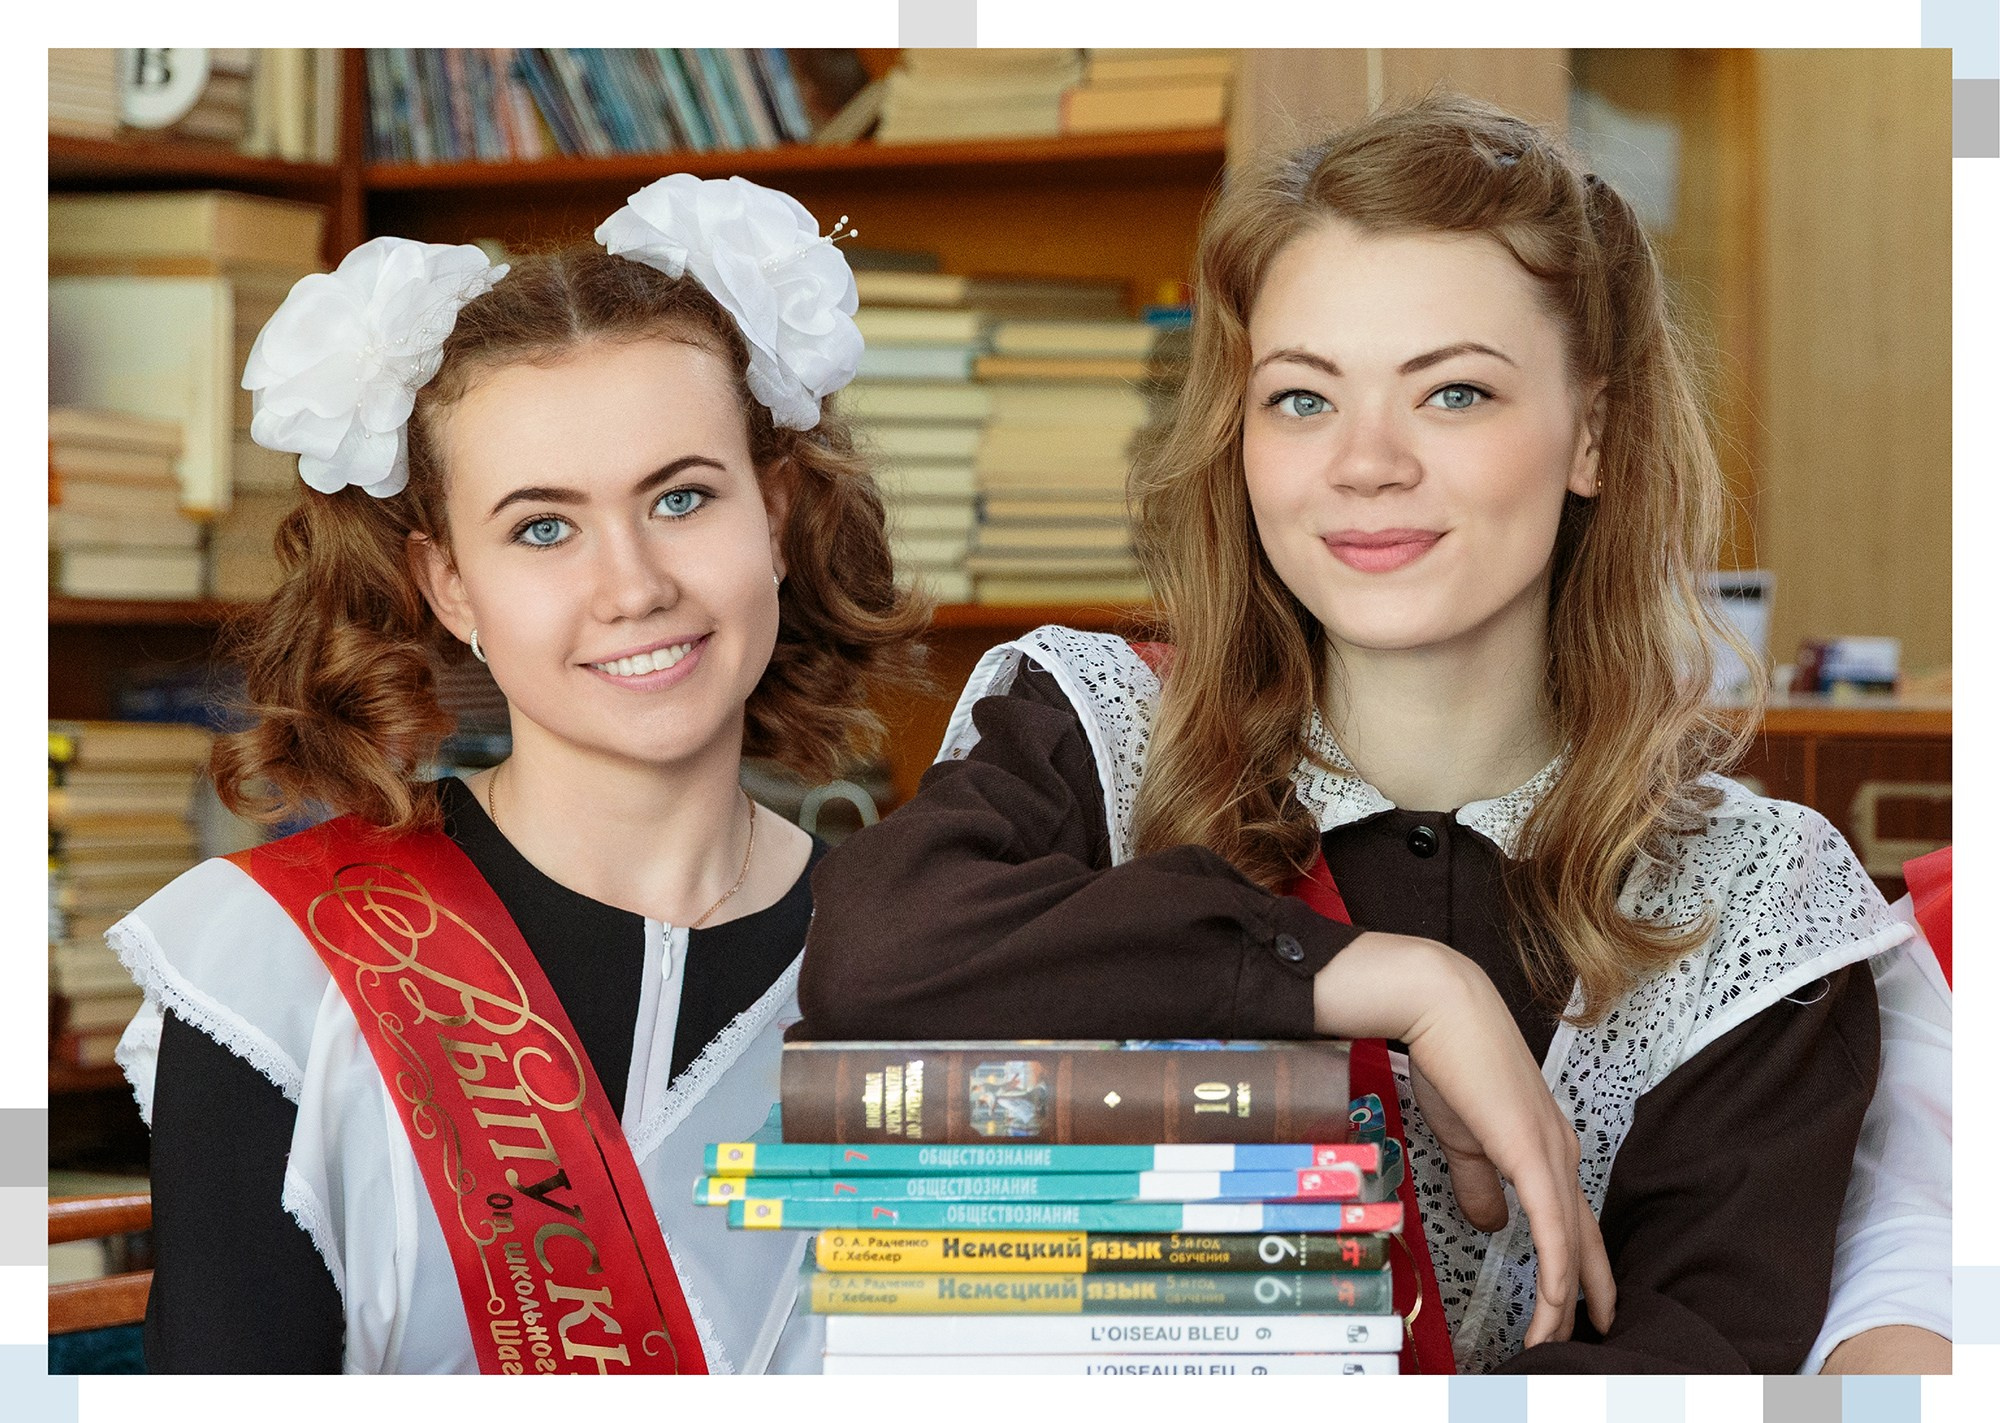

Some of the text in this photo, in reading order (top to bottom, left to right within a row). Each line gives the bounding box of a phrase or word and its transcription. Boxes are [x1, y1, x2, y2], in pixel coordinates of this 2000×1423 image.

[1193, 1082, 1231, 1113] 10
[844, 1148, 1051, 1168] 7 ОБЩЕСТВОЗНАНИЕ
[834, 1177, 1038, 1197] 7 ОБЩЕСТВОЗНАНИЕ
[873, 1205, 1080, 1226] 7 ОБЩЕСТВОЗНАНИЕ
[833, 1236, 929, 1249] О. А. Радченко
[942, 1236, 1163, 1260] Немецкий язык
[1258, 1235, 1298, 1264] 9
[833, 1251, 902, 1263] Г. Хебелер
[1169, 1252, 1231, 1263] ОБУЧЕНИЯ
[864, 1277, 925, 1290] Радченко
[937, 1276, 1158, 1302] Немецкий язык
[1254, 1275, 1293, 1304] 9
[503, 1242, 557, 1375] школьног
[842, 1292, 898, 1305] Хебелер
[1091, 1326, 1182, 1342] L'OISEAU
[1188, 1326, 1240, 1341] BLEU
